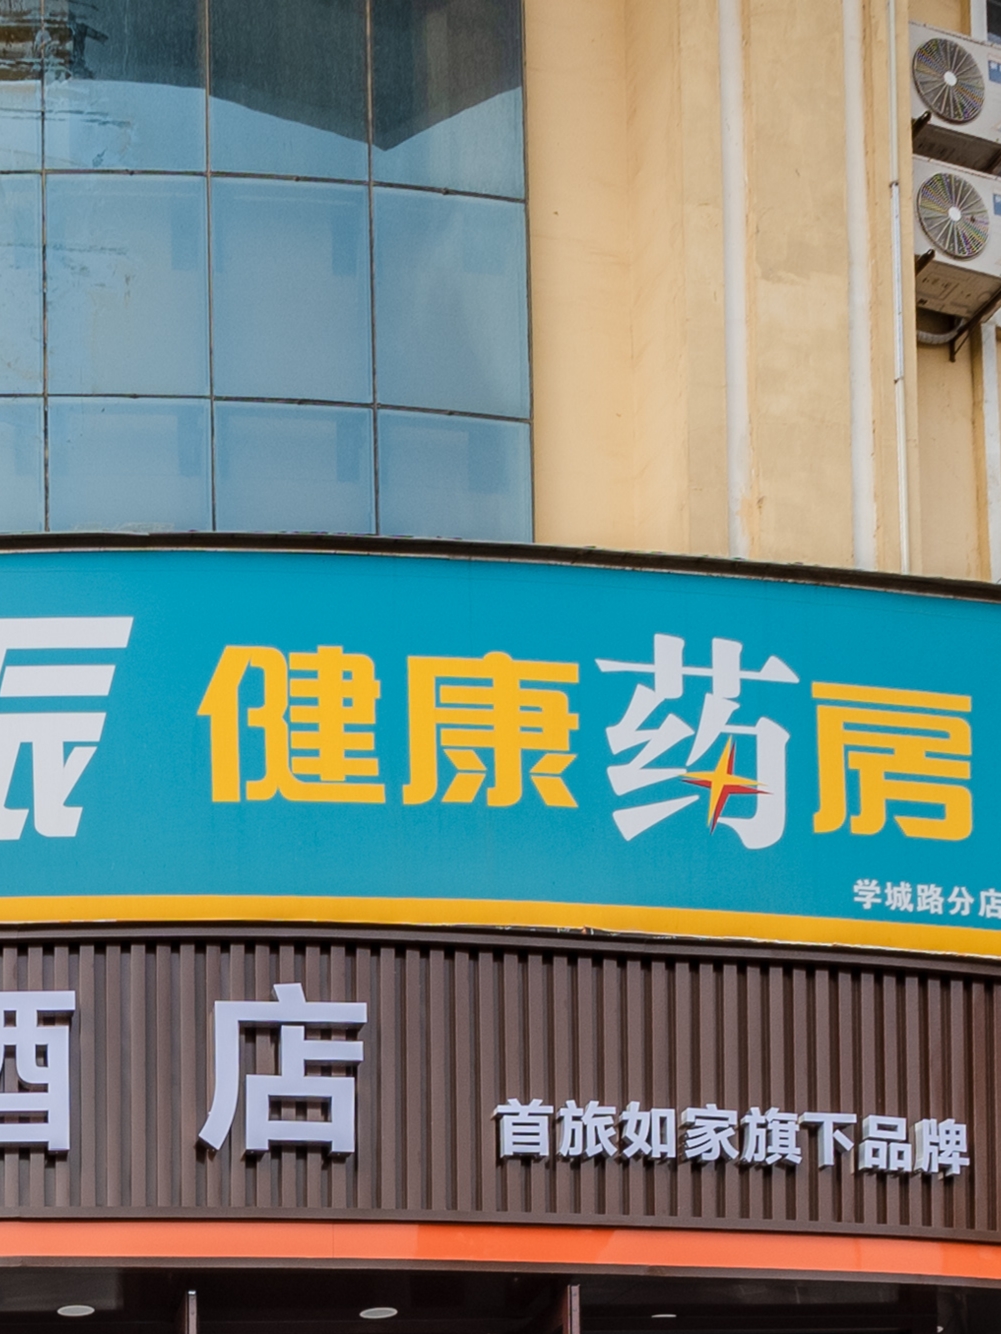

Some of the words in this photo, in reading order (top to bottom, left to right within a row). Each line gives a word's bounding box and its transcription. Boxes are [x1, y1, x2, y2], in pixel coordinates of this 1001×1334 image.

[197, 633, 974, 850] 健康药房
[853, 878, 1001, 920] 学城路分店
[494, 1098, 971, 1177] 首旅如家旗下品牌
